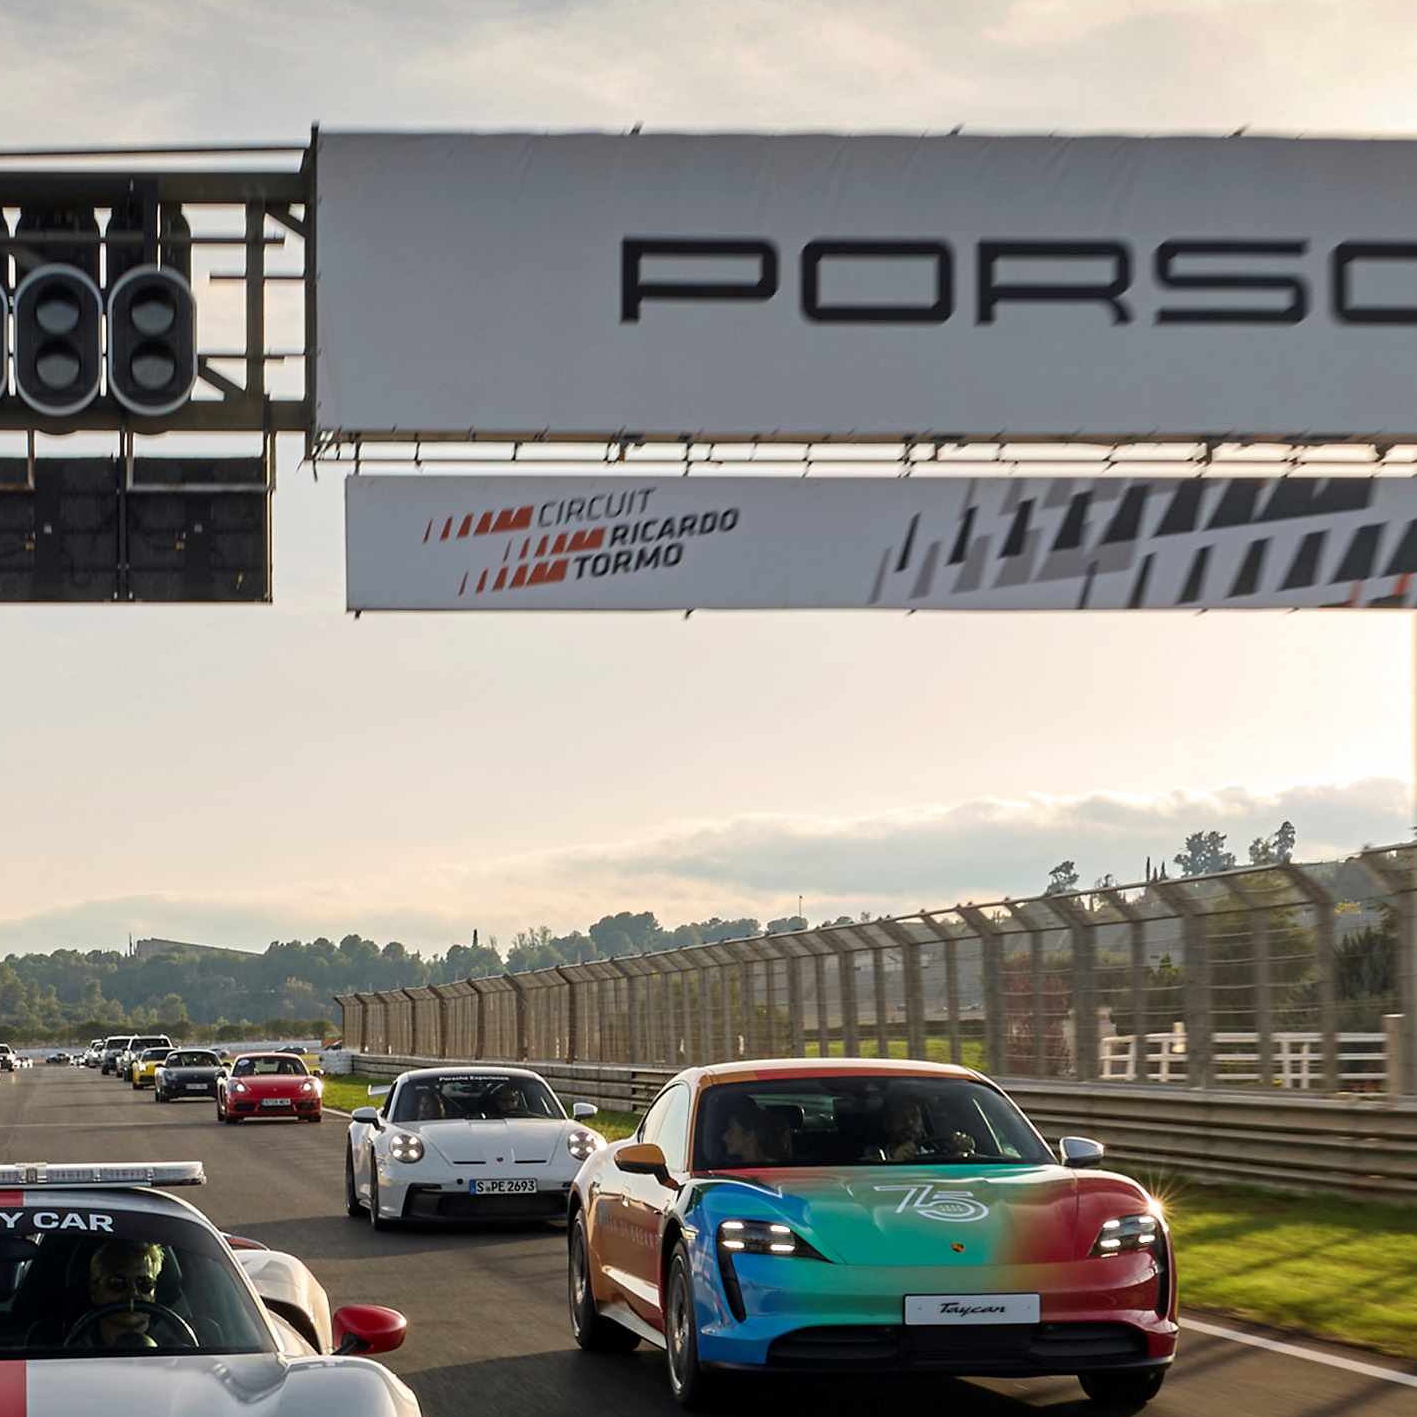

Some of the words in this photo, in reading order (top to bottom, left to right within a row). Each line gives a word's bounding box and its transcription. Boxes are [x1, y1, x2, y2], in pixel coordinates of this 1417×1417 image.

[537, 485, 657, 528] CIRCUIT
[609, 507, 741, 547] RICARDO
[572, 542, 685, 580] TORMO
[33, 1212, 114, 1232] CAR
[940, 1302, 1006, 1317] Taycan
